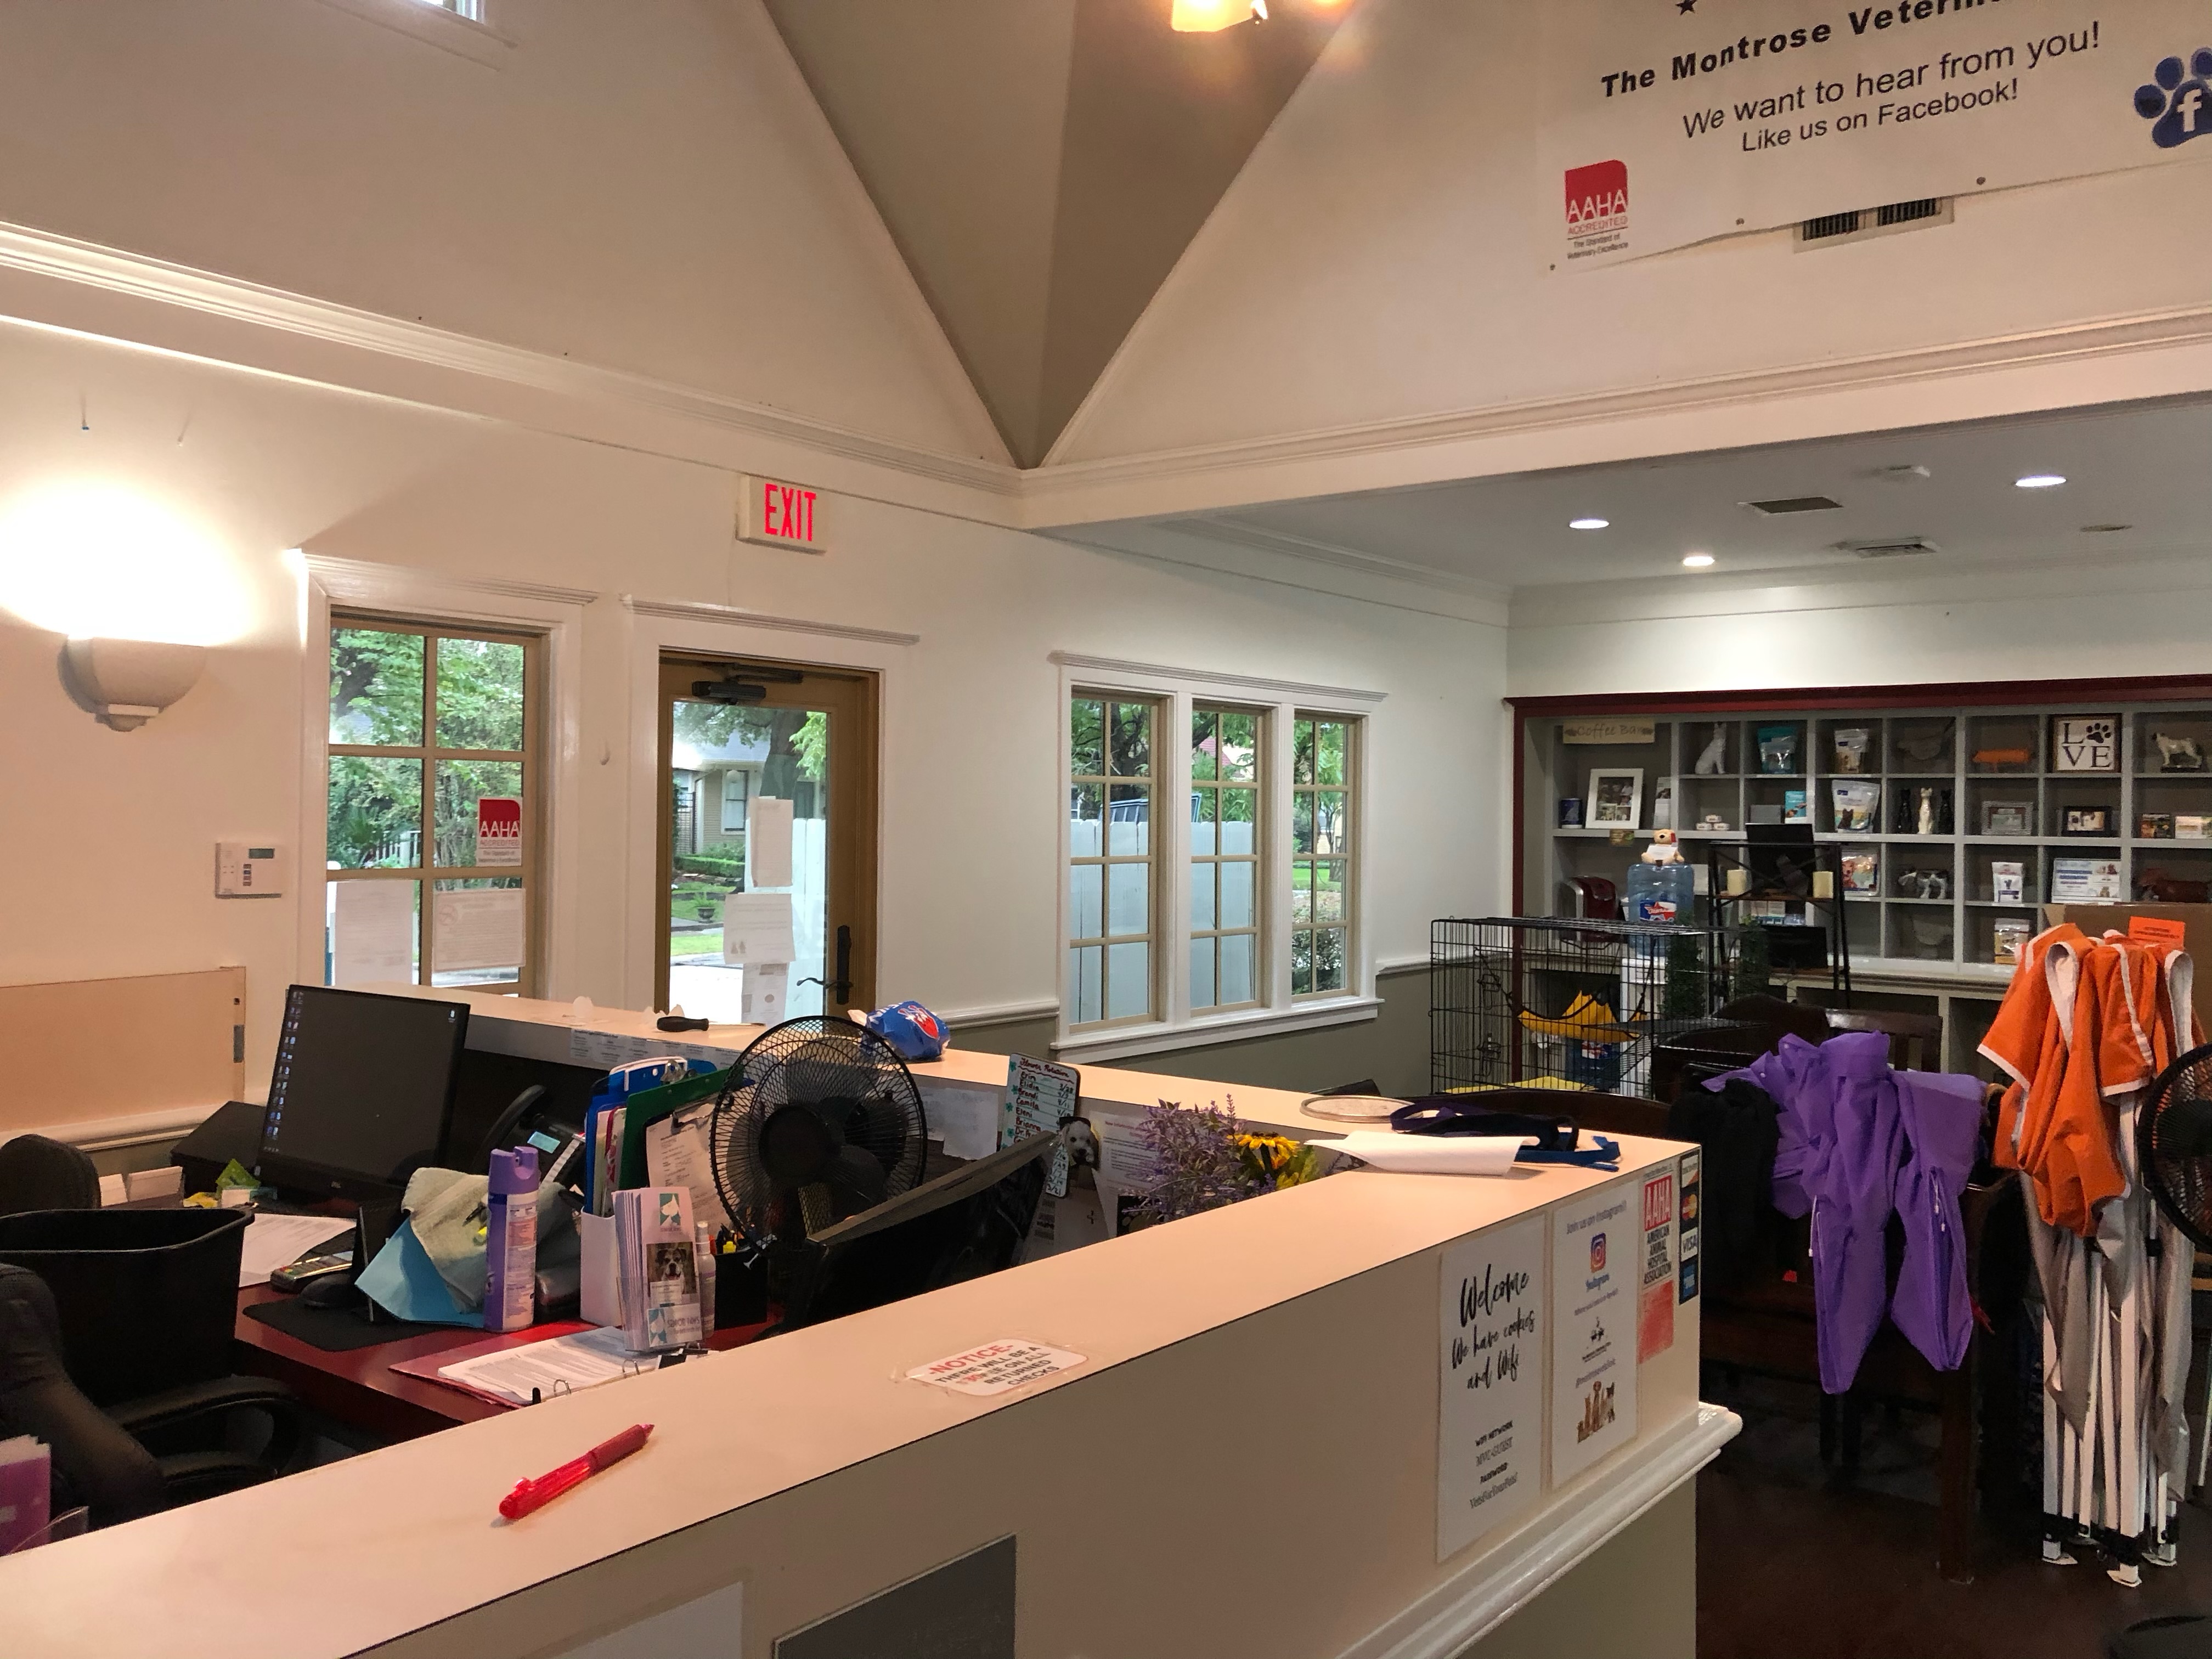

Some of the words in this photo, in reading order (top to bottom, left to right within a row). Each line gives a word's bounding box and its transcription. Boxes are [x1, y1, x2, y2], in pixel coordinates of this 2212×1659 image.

[1601, 69, 1656, 98] The
[1671, 23, 1832, 81] Montrose
[1848, 0, 2000, 35] Veter
[1683, 109, 1725, 138] We
[1734, 85, 1806, 121] want
[1816, 81, 1844, 104] to
[1857, 64, 1928, 98] hear
[1940, 46, 2015, 81] from
[2028, 20, 2100, 68] you!
[1743, 128, 1791, 152] Like
[1801, 119, 1827, 141] us
[1837, 112, 1867, 132] on
[1879, 78, 2019, 126] Facebook!
[1567, 189, 1628, 224] AAHA
[1567, 215, 1628, 235] ACCREDITED
[765, 483, 817, 541] EXIT
[1577, 723, 1616, 739] Coffee
[479, 820, 520, 838] AAHA
[1020, 1057, 1042, 1071] Flower
[1021, 1071, 1036, 1081] Erin
[1645, 1178, 1671, 1229] AAHA
[1682, 1233, 1698, 1253] VISA
[1460, 1263, 1530, 1328] Welcome
[1452, 1337, 1470, 1369] We
[1474, 1324, 1499, 1357] have
[1503, 1307, 1536, 1339] cookies
[978, 1357, 1013, 1368] WILL
[1008, 1349, 1029, 1358] BE
[1005, 1359, 1027, 1368] ON
[1024, 1352, 1052, 1362] ALL
[984, 1359, 1052, 1385] RETURNED
[1007, 1365, 1060, 1386] CHECKS
[1467, 1356, 1492, 1390] and
